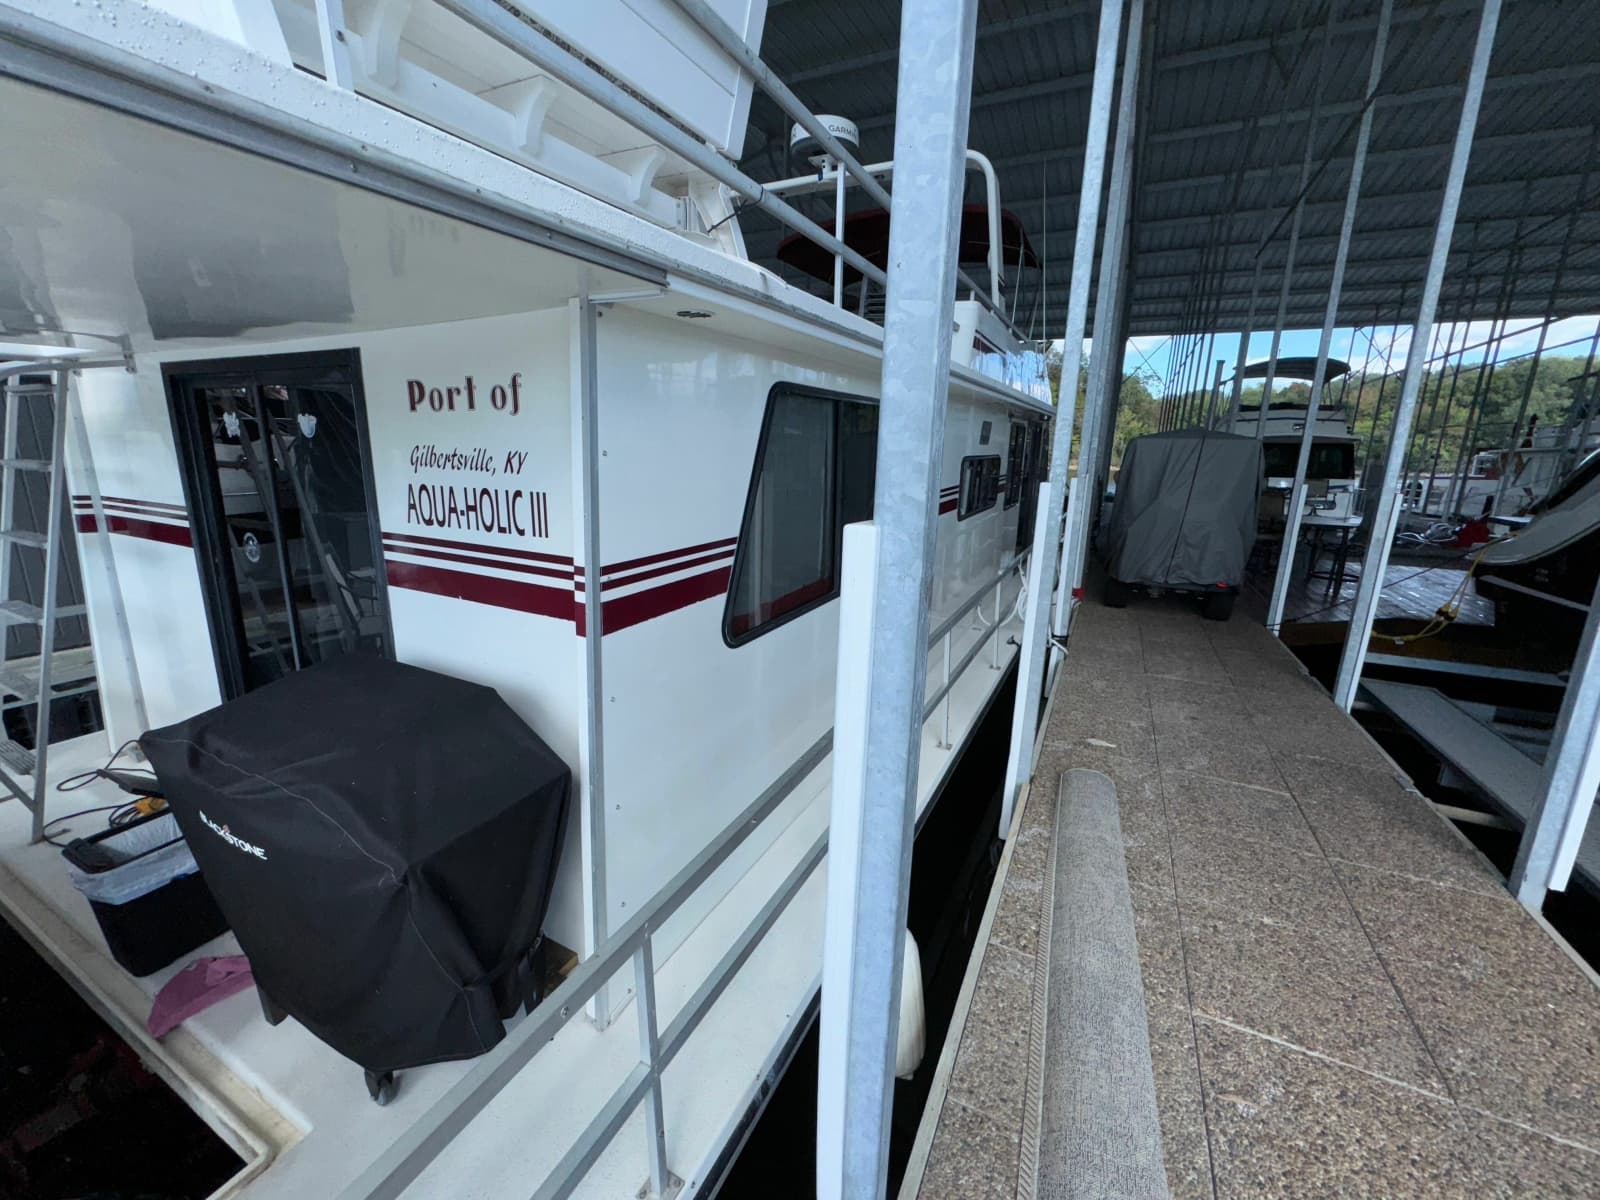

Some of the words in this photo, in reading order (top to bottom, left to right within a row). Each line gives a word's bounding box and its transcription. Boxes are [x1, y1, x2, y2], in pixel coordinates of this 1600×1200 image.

[407, 376, 476, 412] Port
[490, 372, 522, 416] of
[410, 444, 496, 477] Gilbertsville,
[503, 450, 528, 475] KY
[407, 483, 526, 537] AQUA-HOLIC
[529, 491, 549, 538] III
